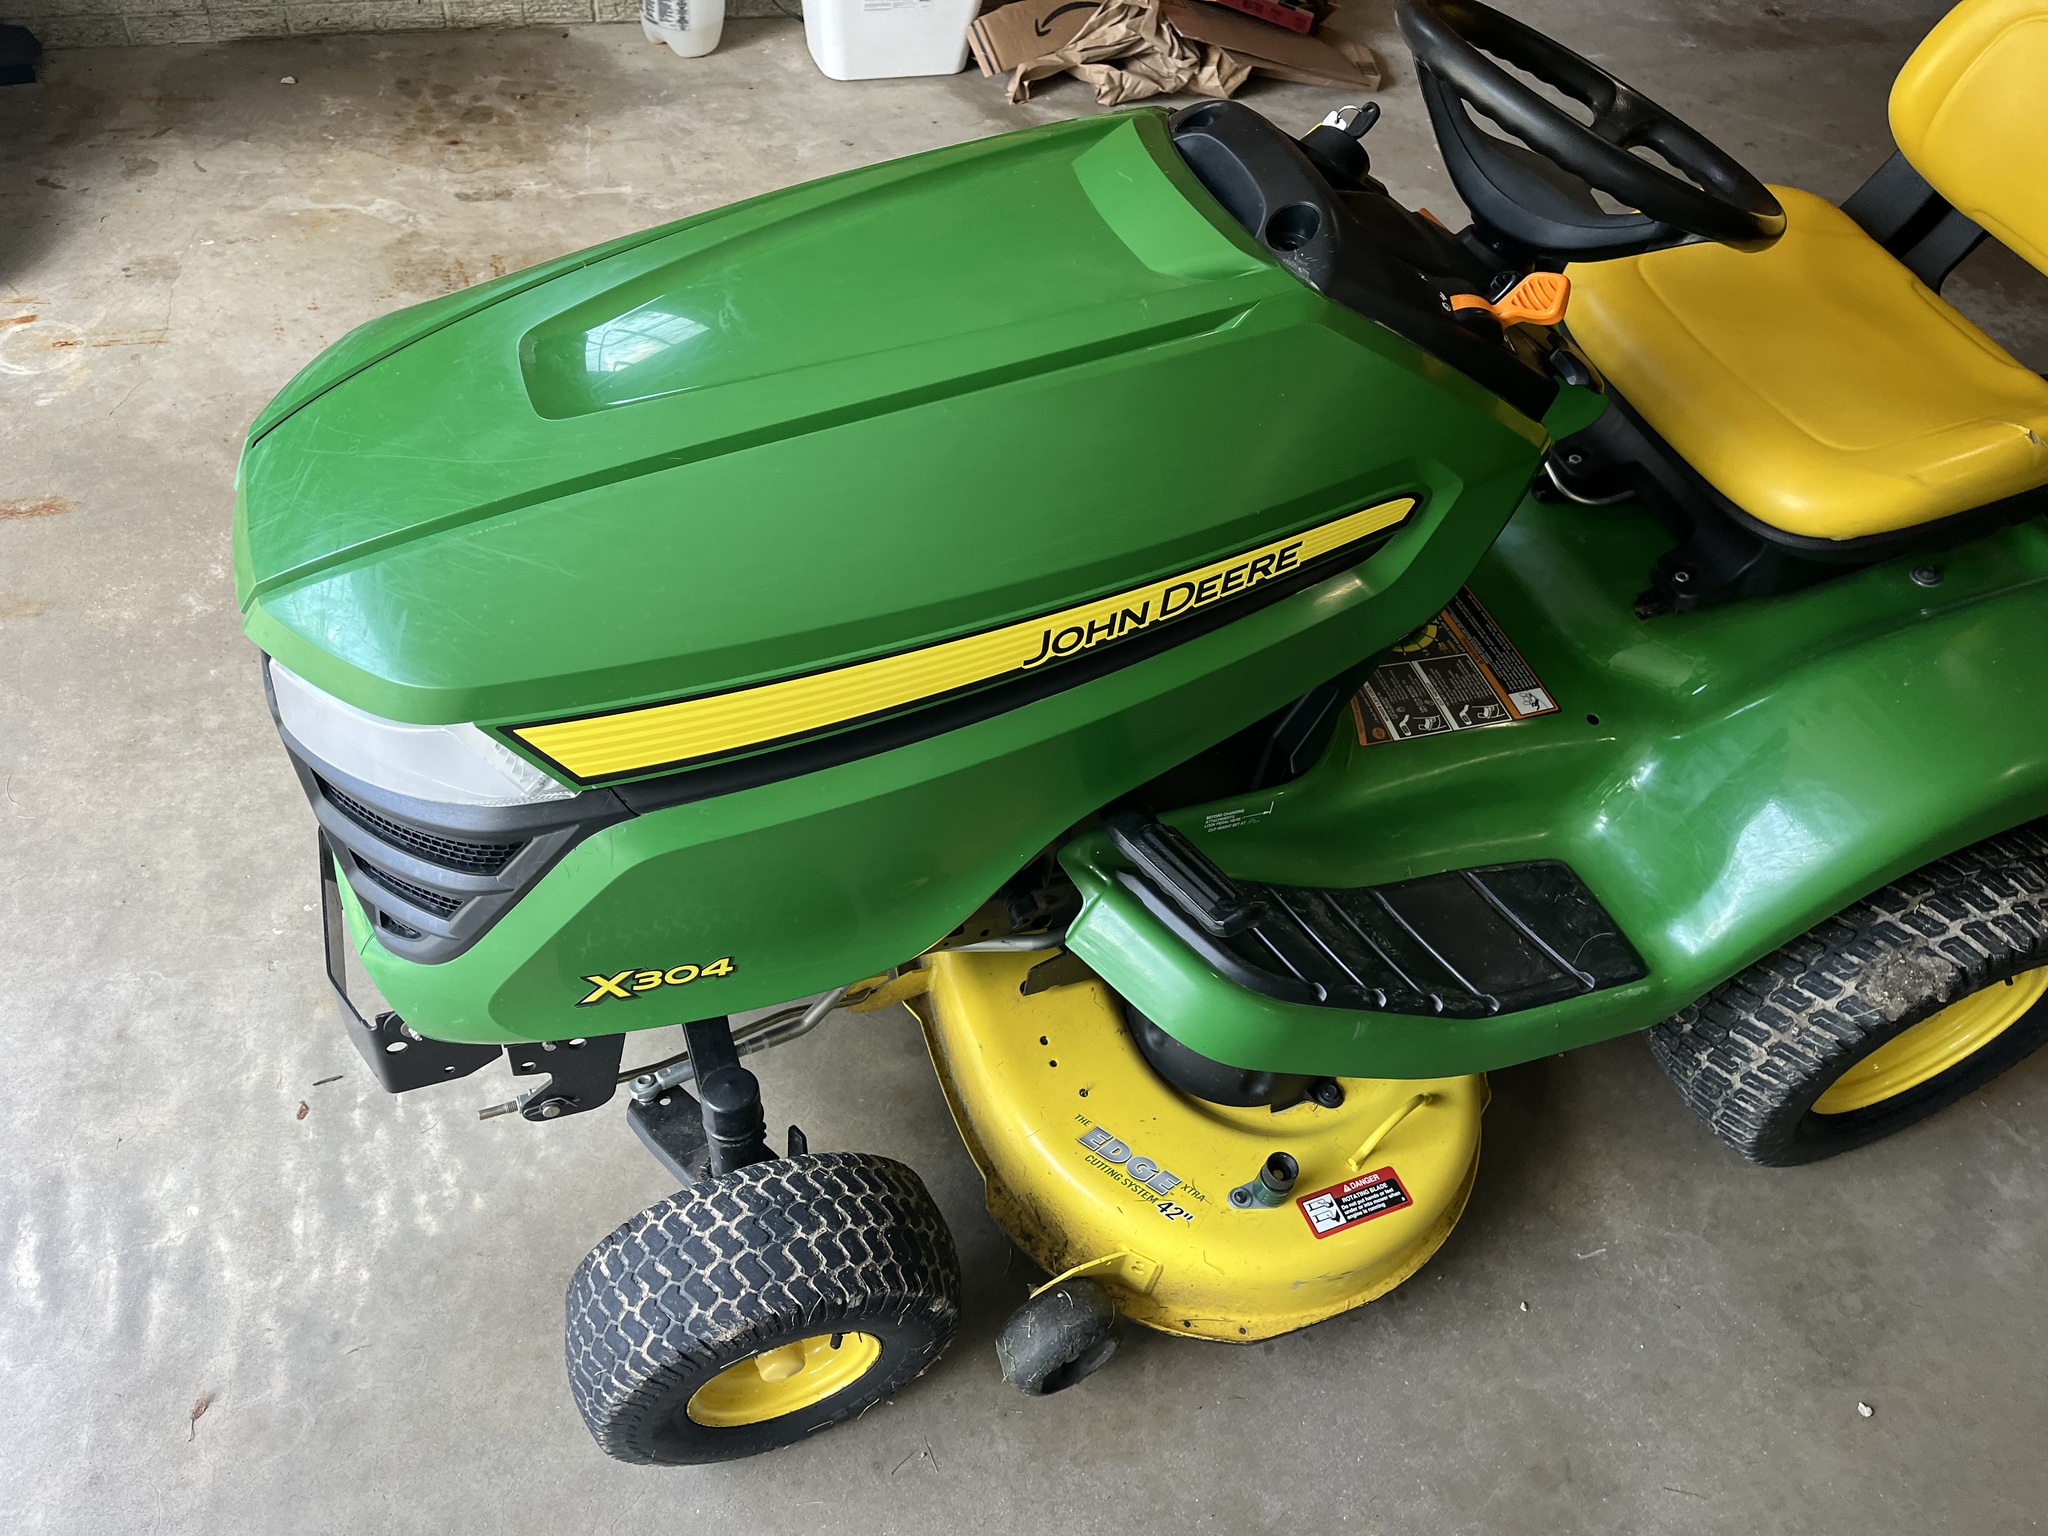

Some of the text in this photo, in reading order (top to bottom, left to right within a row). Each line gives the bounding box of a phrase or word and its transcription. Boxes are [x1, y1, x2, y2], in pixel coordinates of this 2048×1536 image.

[1022, 541, 1304, 667] JOHN DEERE
[575, 957, 736, 1006] X304
[1074, 1113, 1092, 1127] THE
[1076, 1125, 1206, 1202] EDGE XTRA
[1085, 1154, 1195, 1222] CUTTING SYSTEM 42"
[1349, 1174, 1380, 1189] DANGER
[1342, 1182, 1388, 1203] ROTATING BLADE
[1373, 1196, 1388, 1204] mower
[1389, 1191, 1401, 1199] when
[1347, 1211, 1363, 1220] engine
[1368, 1202, 1386, 1212] running
